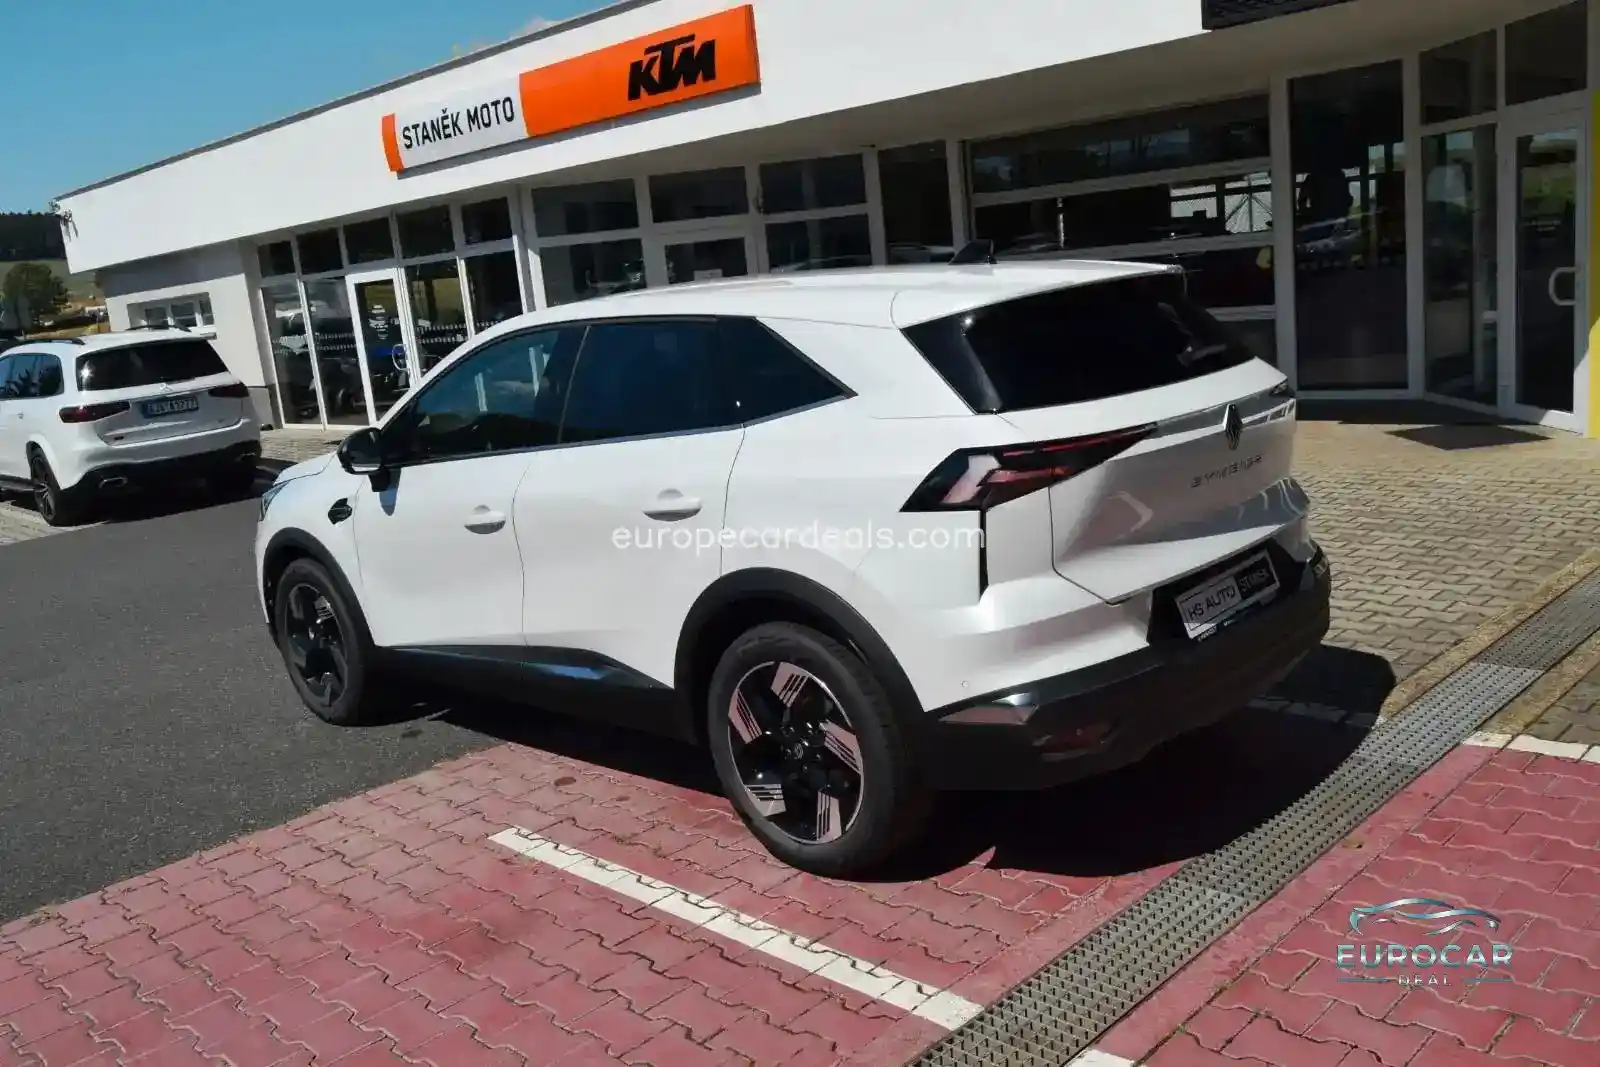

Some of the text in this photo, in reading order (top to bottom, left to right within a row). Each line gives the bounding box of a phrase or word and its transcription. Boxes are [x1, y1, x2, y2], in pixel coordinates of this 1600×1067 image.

[628, 34, 716, 101] KTM
[402, 96, 515, 149] STANĚK MOTO
[1188, 602, 1204, 621] HS
[1206, 586, 1236, 609] AUTO
